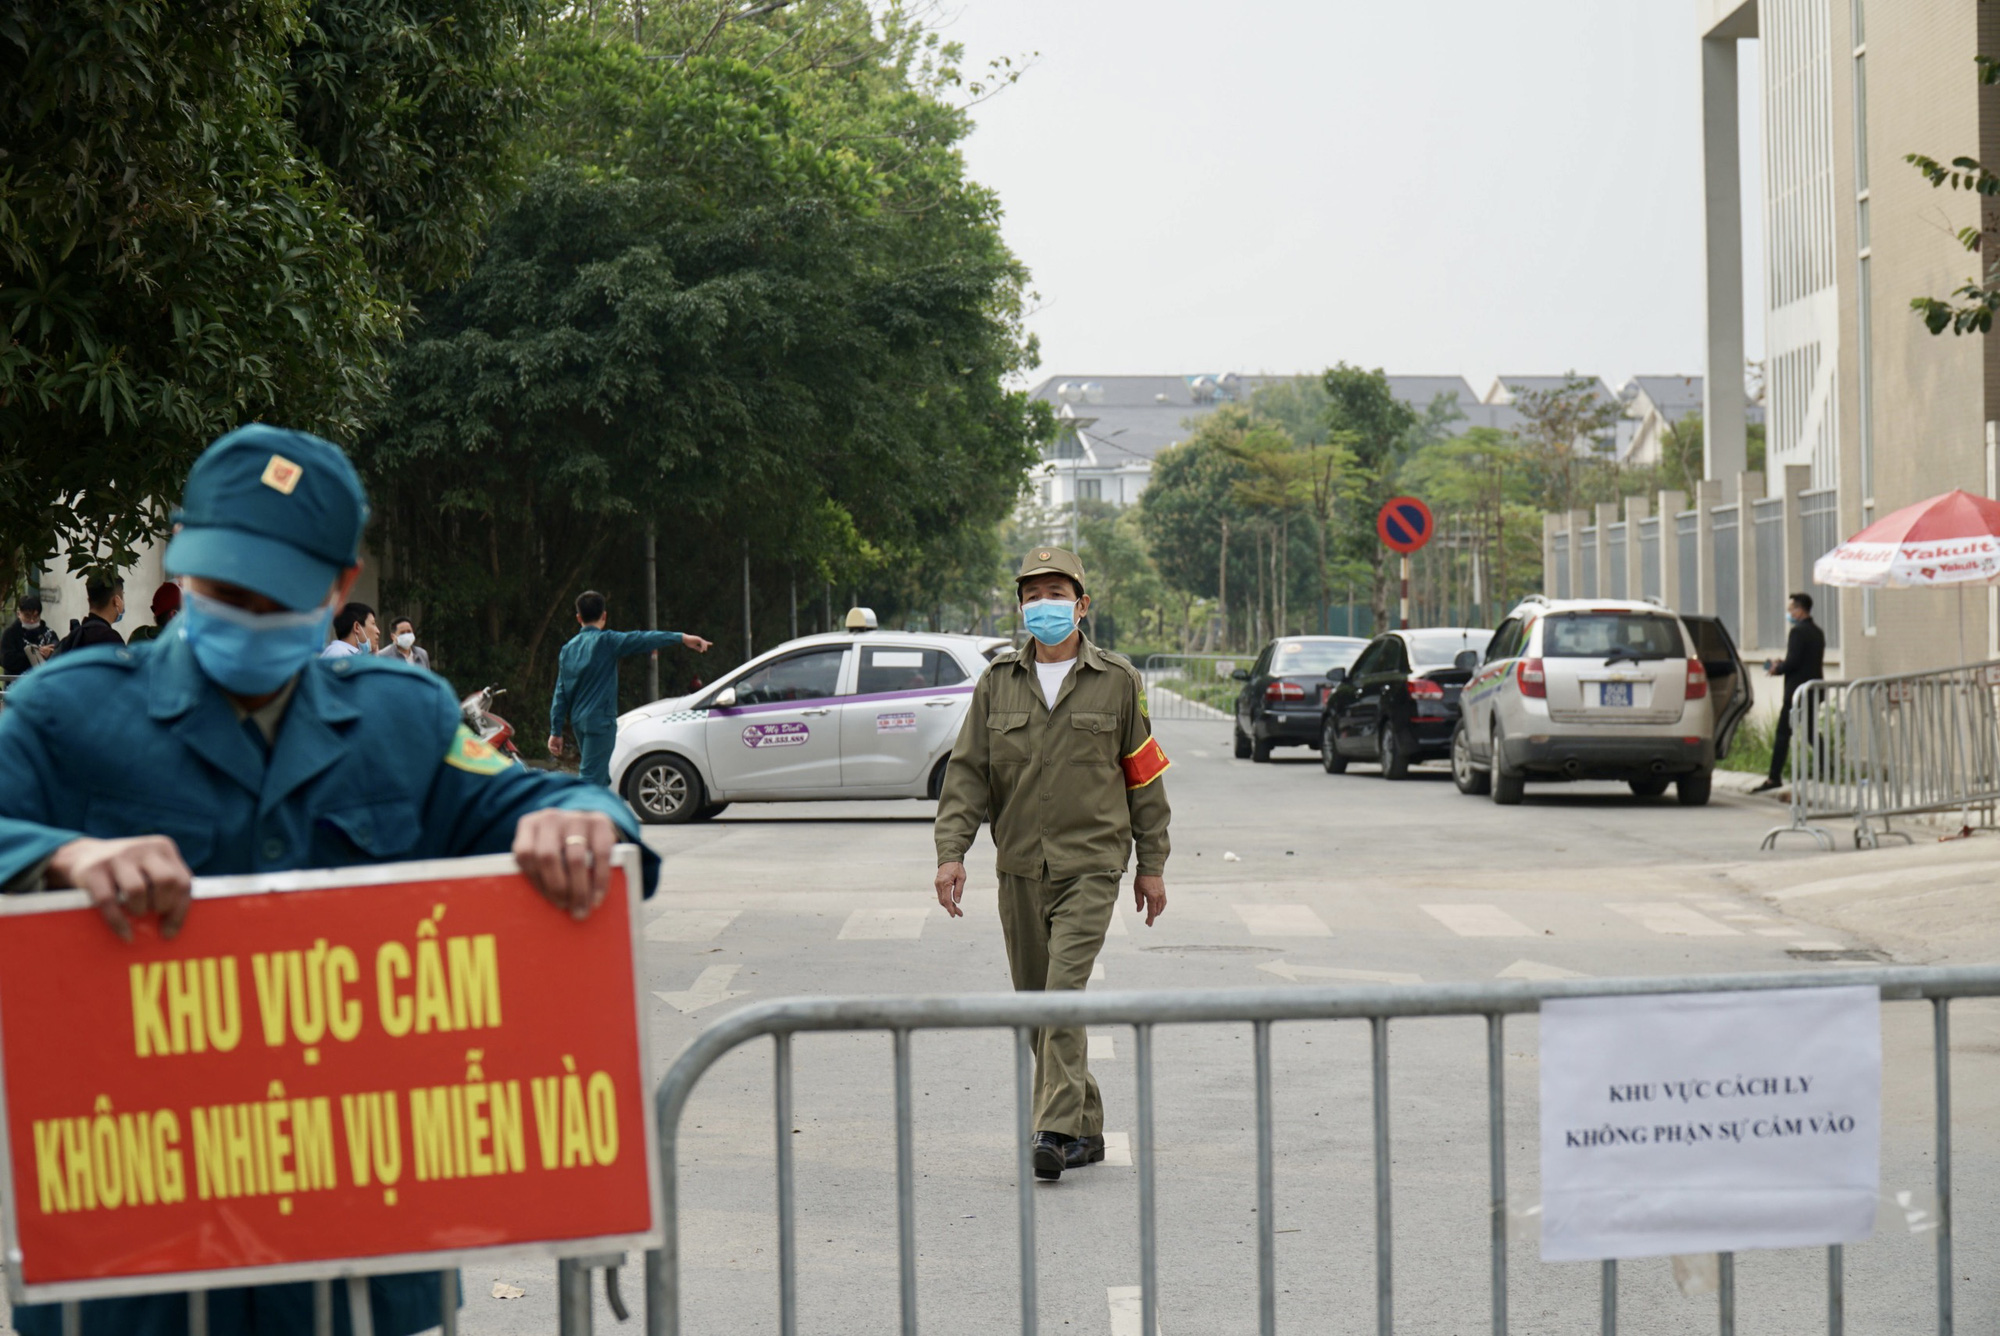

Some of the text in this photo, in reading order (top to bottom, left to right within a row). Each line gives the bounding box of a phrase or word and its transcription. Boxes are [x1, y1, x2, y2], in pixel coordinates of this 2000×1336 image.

[1833, 547, 1893, 563] Yakult
[1901, 542, 1994, 560] Yakult
[130, 903, 501, 1065] KHU VỰC CẤM
[1608, 1074, 1813, 1104] KHU VỰC CÁCH LY
[33, 1049, 620, 1215] KHÔNG NHIỆM VỤ MIỄN VÀO
[1566, 1123, 1648, 1148] KHÔNG
[1719, 1118, 1749, 1143] SỰ
[1808, 1111, 1855, 1135] VÀO
